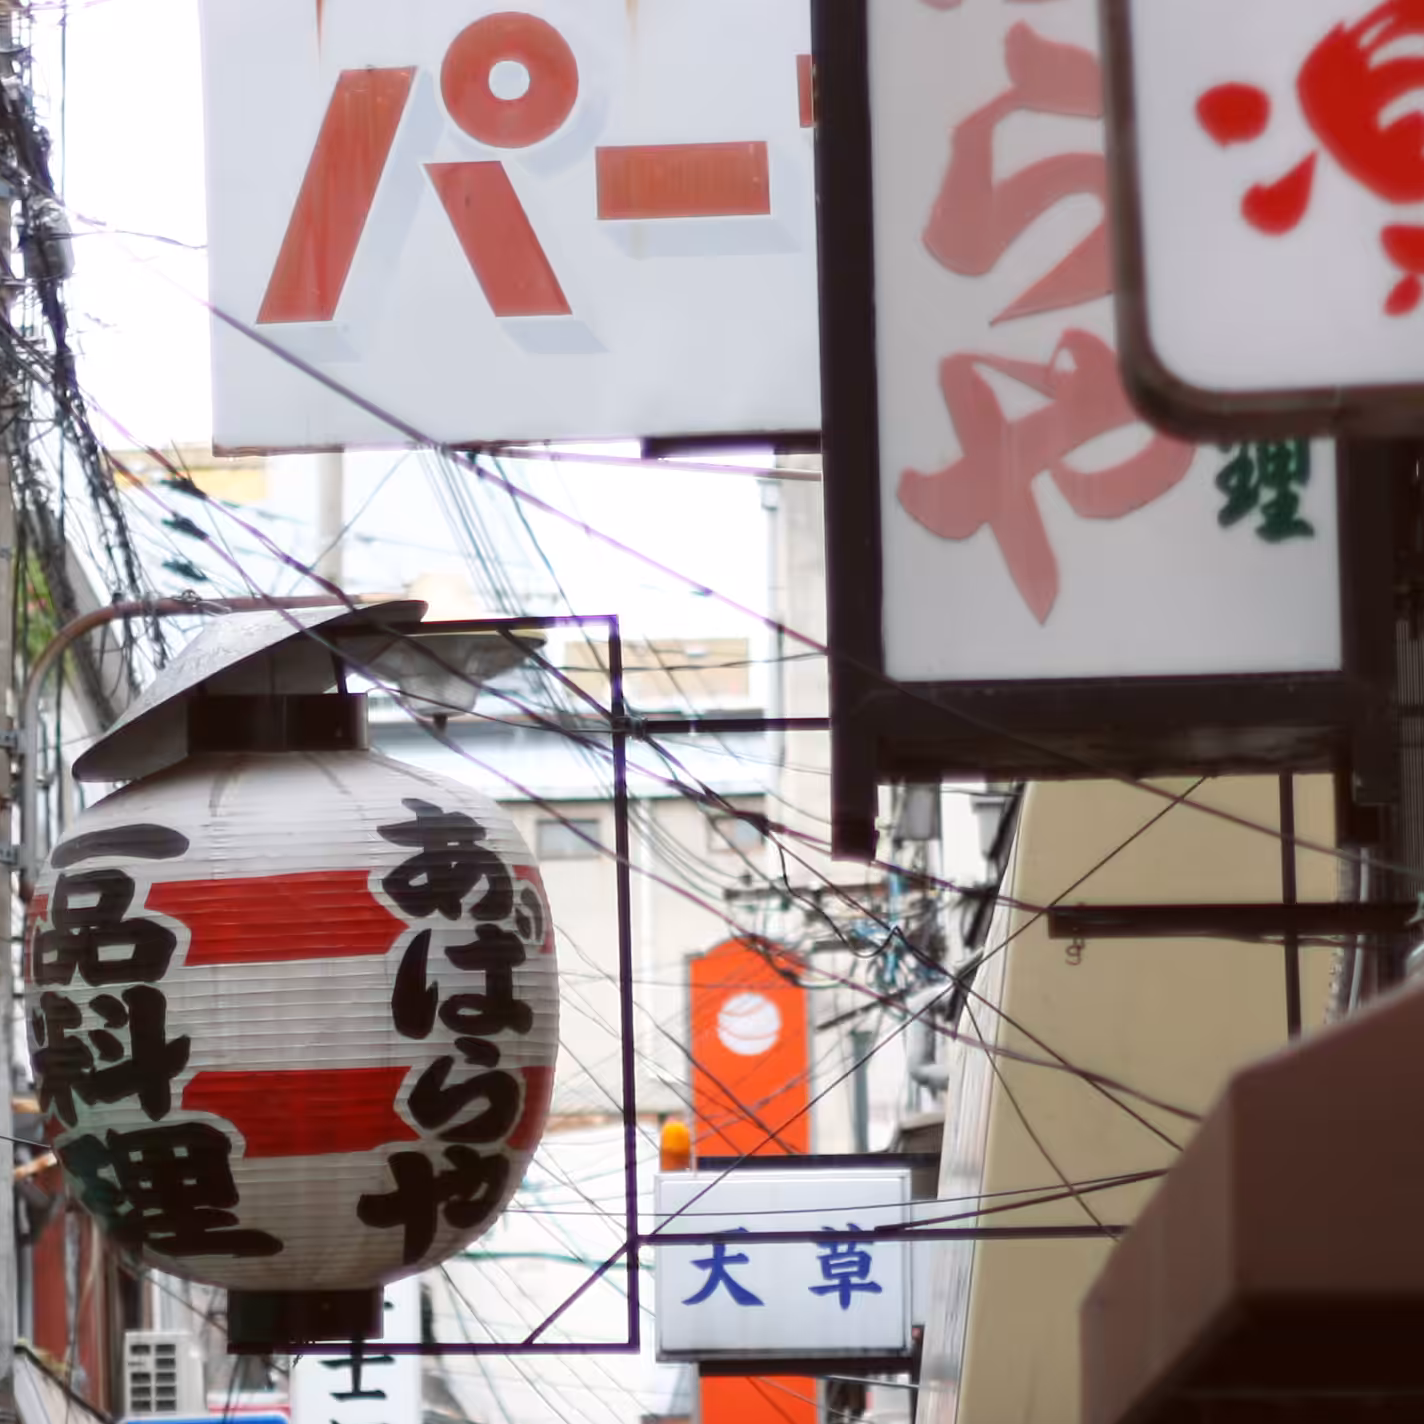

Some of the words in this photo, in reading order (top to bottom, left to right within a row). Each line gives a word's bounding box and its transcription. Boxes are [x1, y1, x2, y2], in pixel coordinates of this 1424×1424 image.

[256, 12, 814, 323] パー
[897, 0, 1198, 625] らや
[30, 822, 284, 1258] 一品料理
[681, 1224, 884, 1311] 天草
